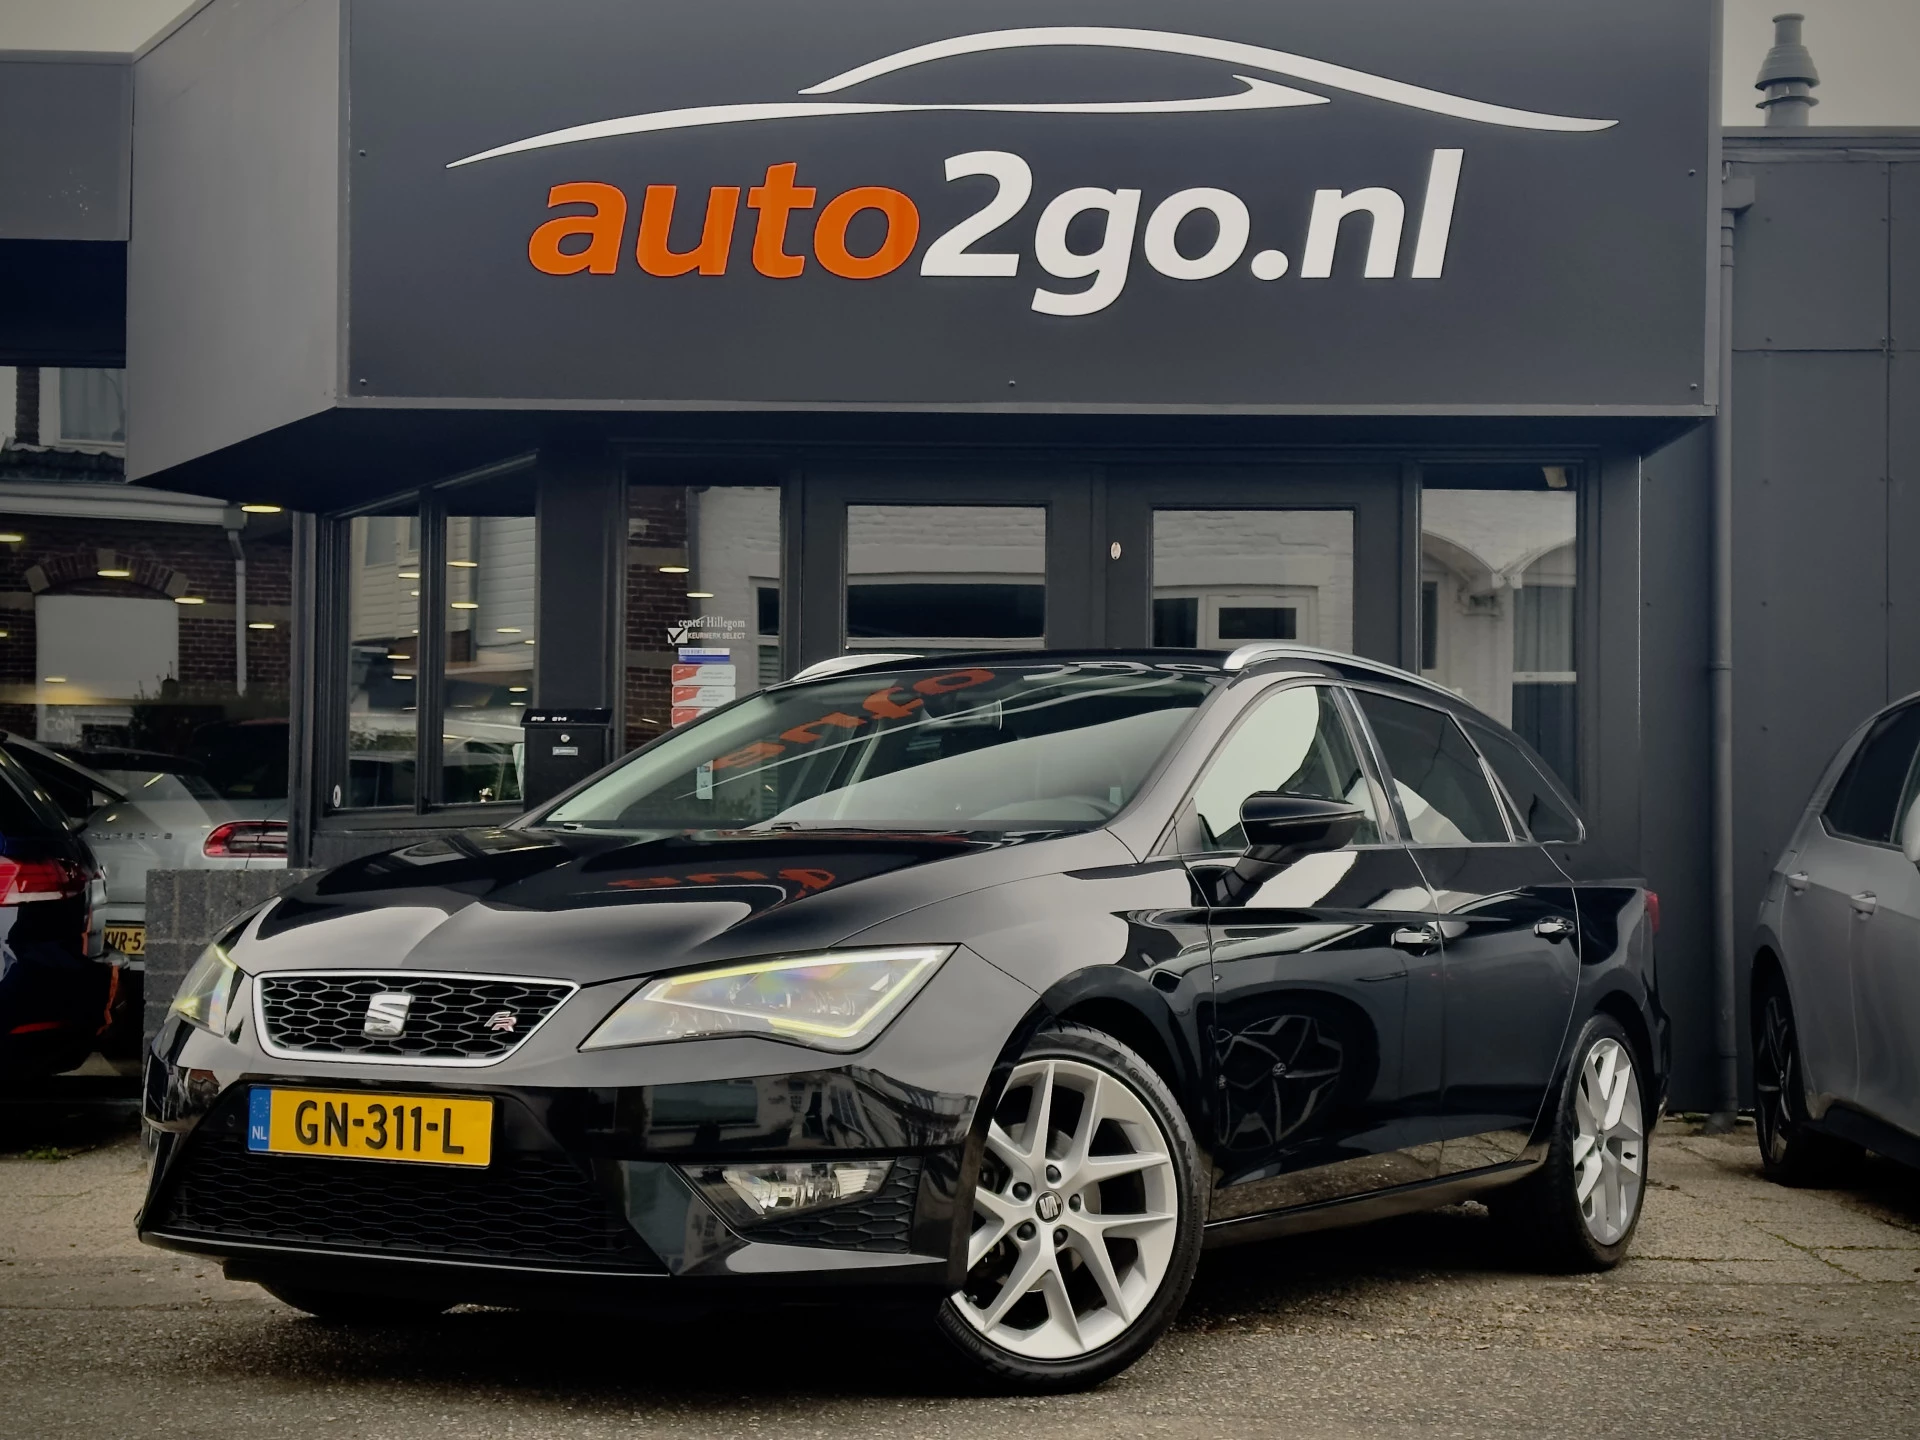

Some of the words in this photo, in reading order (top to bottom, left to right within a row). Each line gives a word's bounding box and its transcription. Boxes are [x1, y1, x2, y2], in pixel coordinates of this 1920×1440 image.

[528, 148, 1464, 316] auto2go.nl
[706, 616, 746, 631] Hillegom
[722, 632, 746, 640] SELECT
[105, 931, 145, 951] VR-5
[252, 1125, 268, 1141] NL
[295, 1100, 465, 1155] GN-311-L
